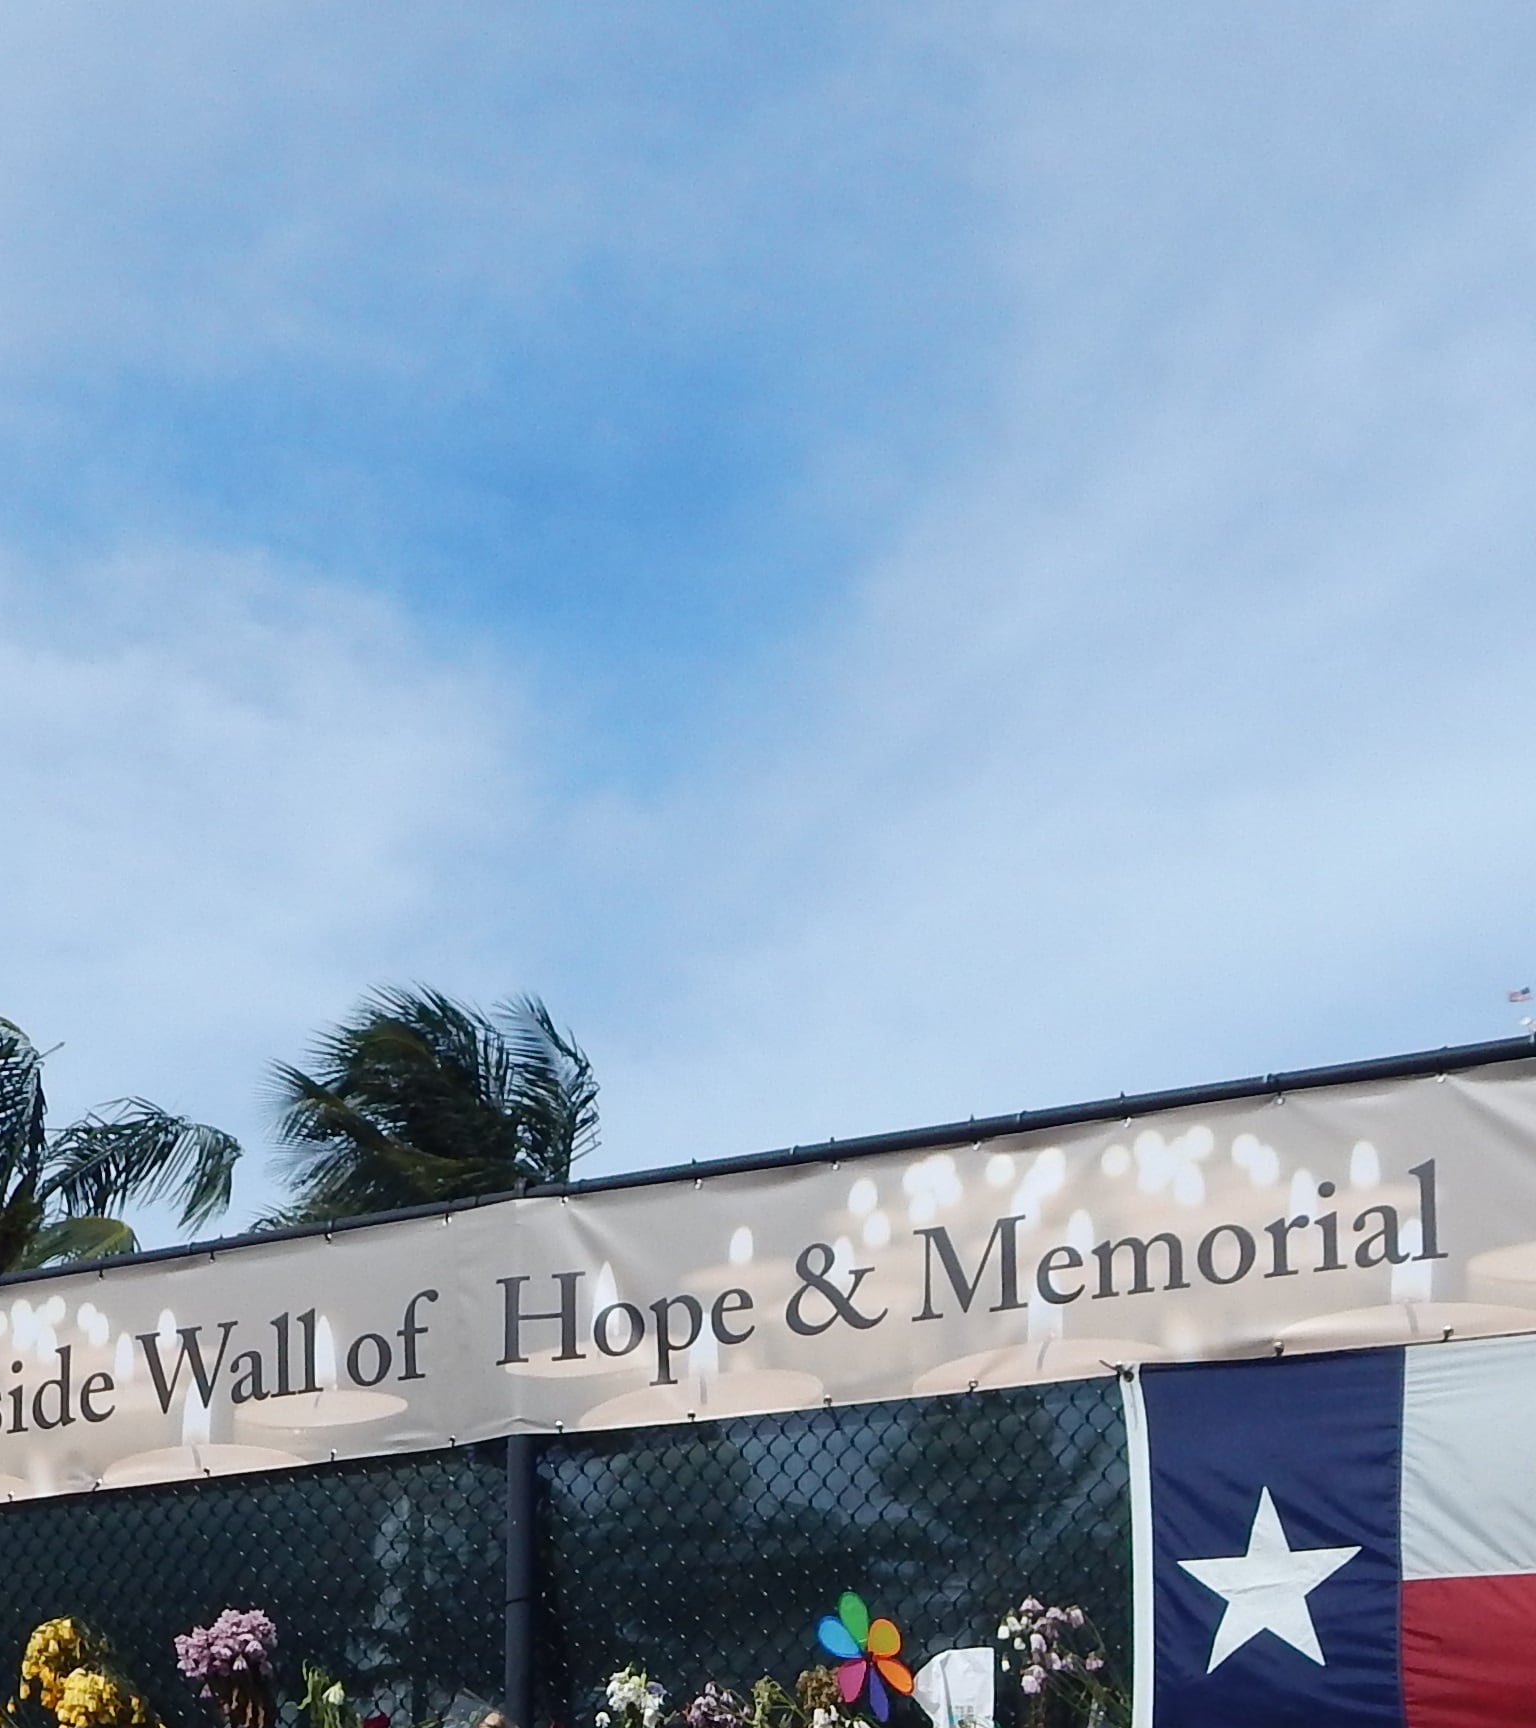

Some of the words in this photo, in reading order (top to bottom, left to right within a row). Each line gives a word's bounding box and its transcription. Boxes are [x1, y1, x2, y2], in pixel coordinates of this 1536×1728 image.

[136, 1307, 323, 1415] Wall
[346, 1289, 439, 1387] of
[496, 1270, 755, 1385] Hope
[785, 1242, 888, 1337] &
[911, 1157, 1450, 1320] Memorial
